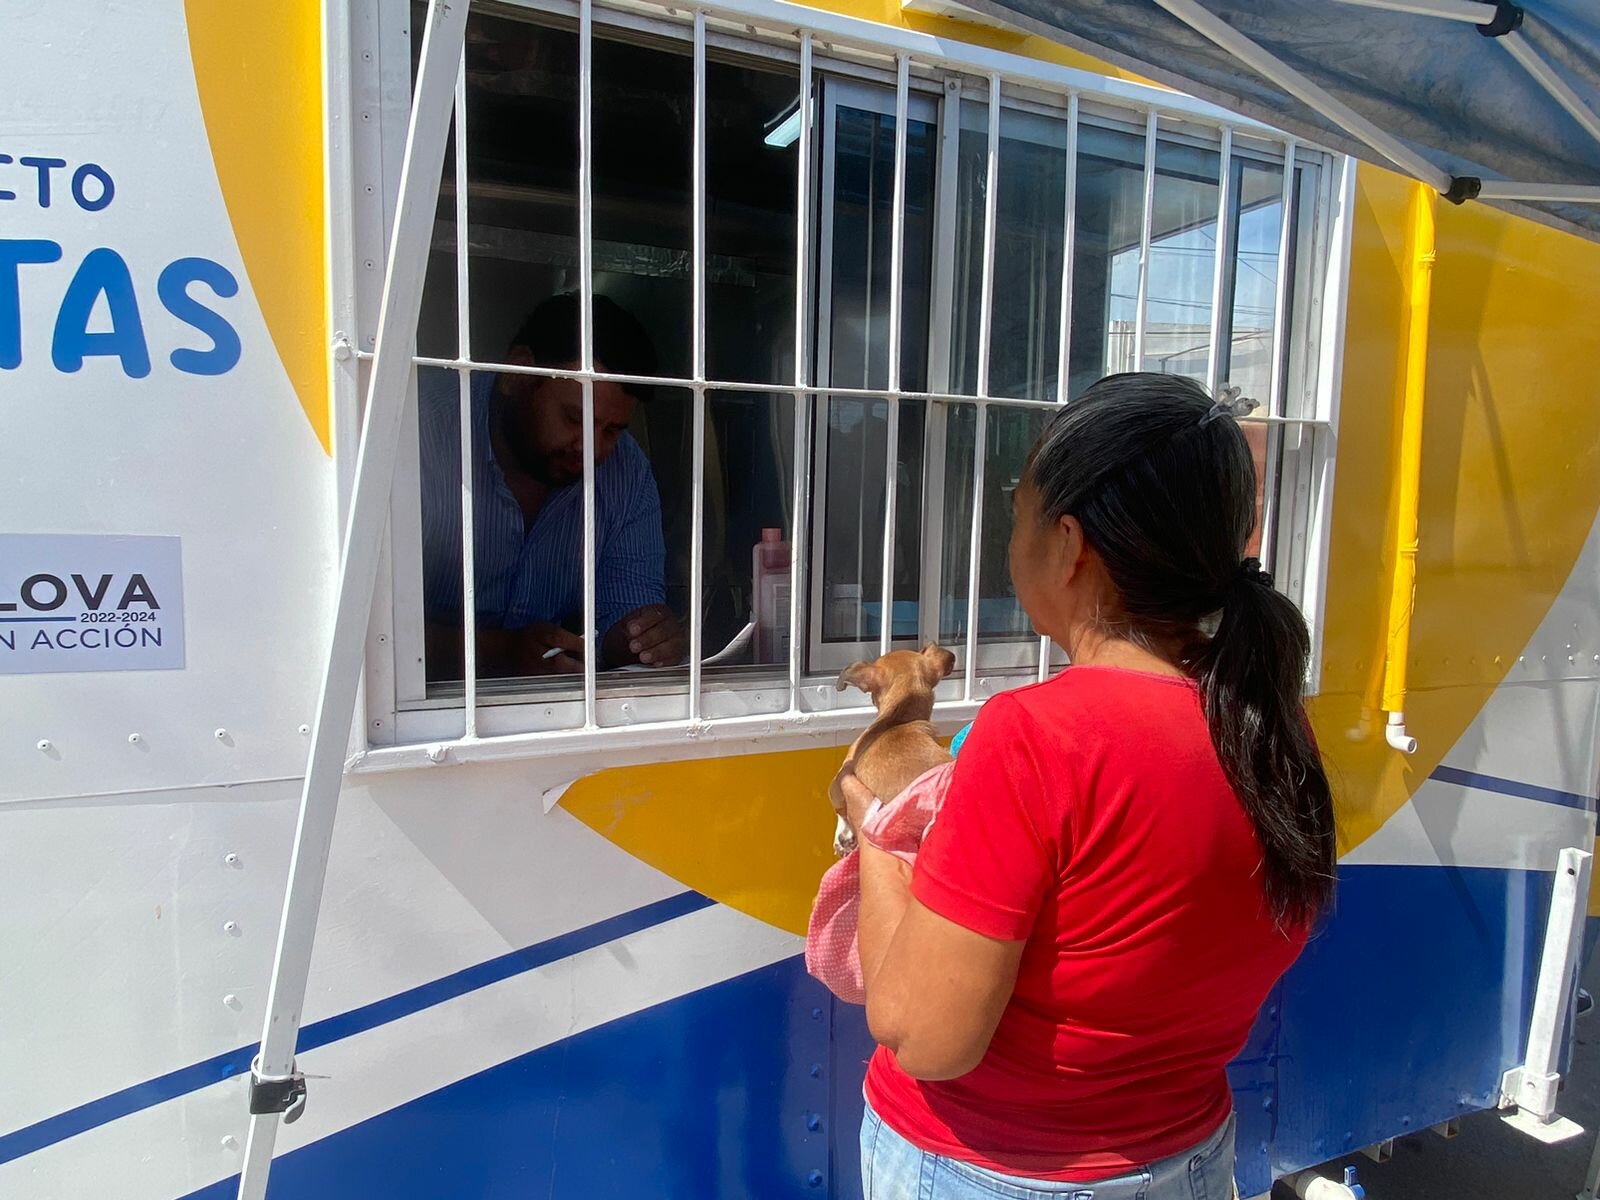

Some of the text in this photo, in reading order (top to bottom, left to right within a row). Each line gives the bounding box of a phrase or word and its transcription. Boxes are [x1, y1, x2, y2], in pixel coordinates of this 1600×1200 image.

[0, 239, 242, 379] TAS
[80, 611, 157, 623] 2022-2024
[30, 623, 162, 650] ACCIÓN
